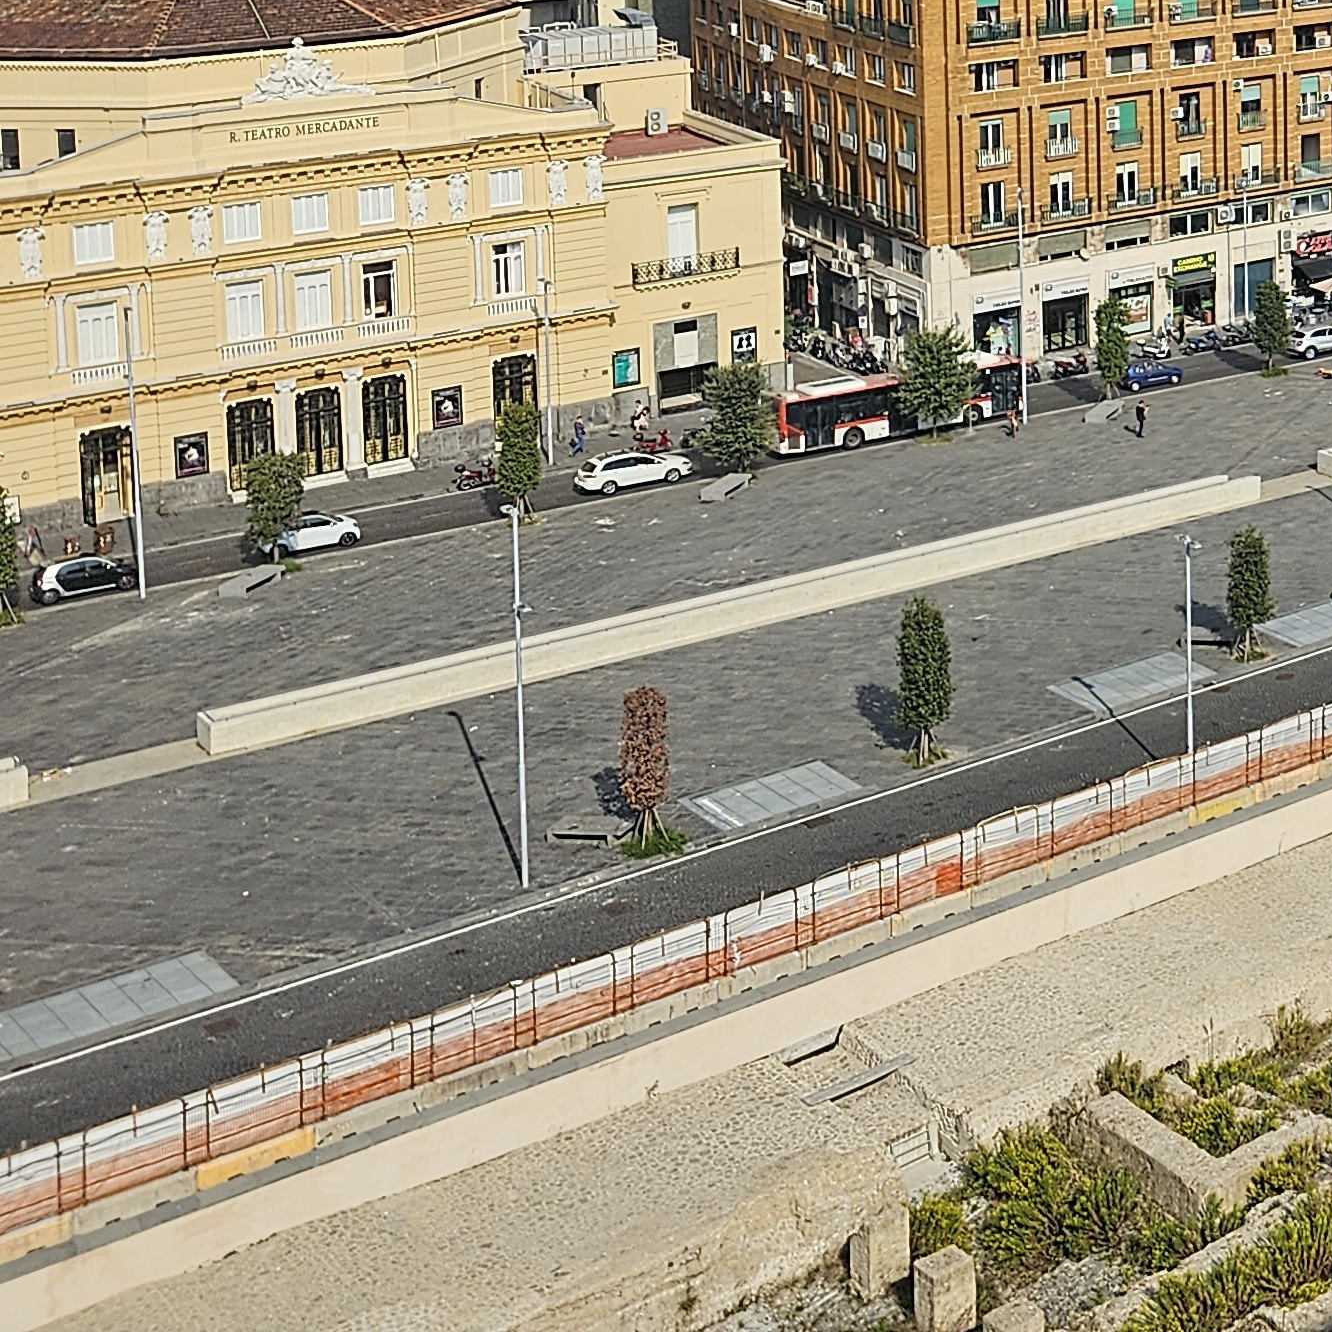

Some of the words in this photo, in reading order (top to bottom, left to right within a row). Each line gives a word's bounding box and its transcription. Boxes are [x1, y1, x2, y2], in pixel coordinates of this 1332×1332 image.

[229, 131, 241, 143] R.
[243, 126, 291, 142] TEATRO
[296, 116, 380, 136] MERCADANTE
